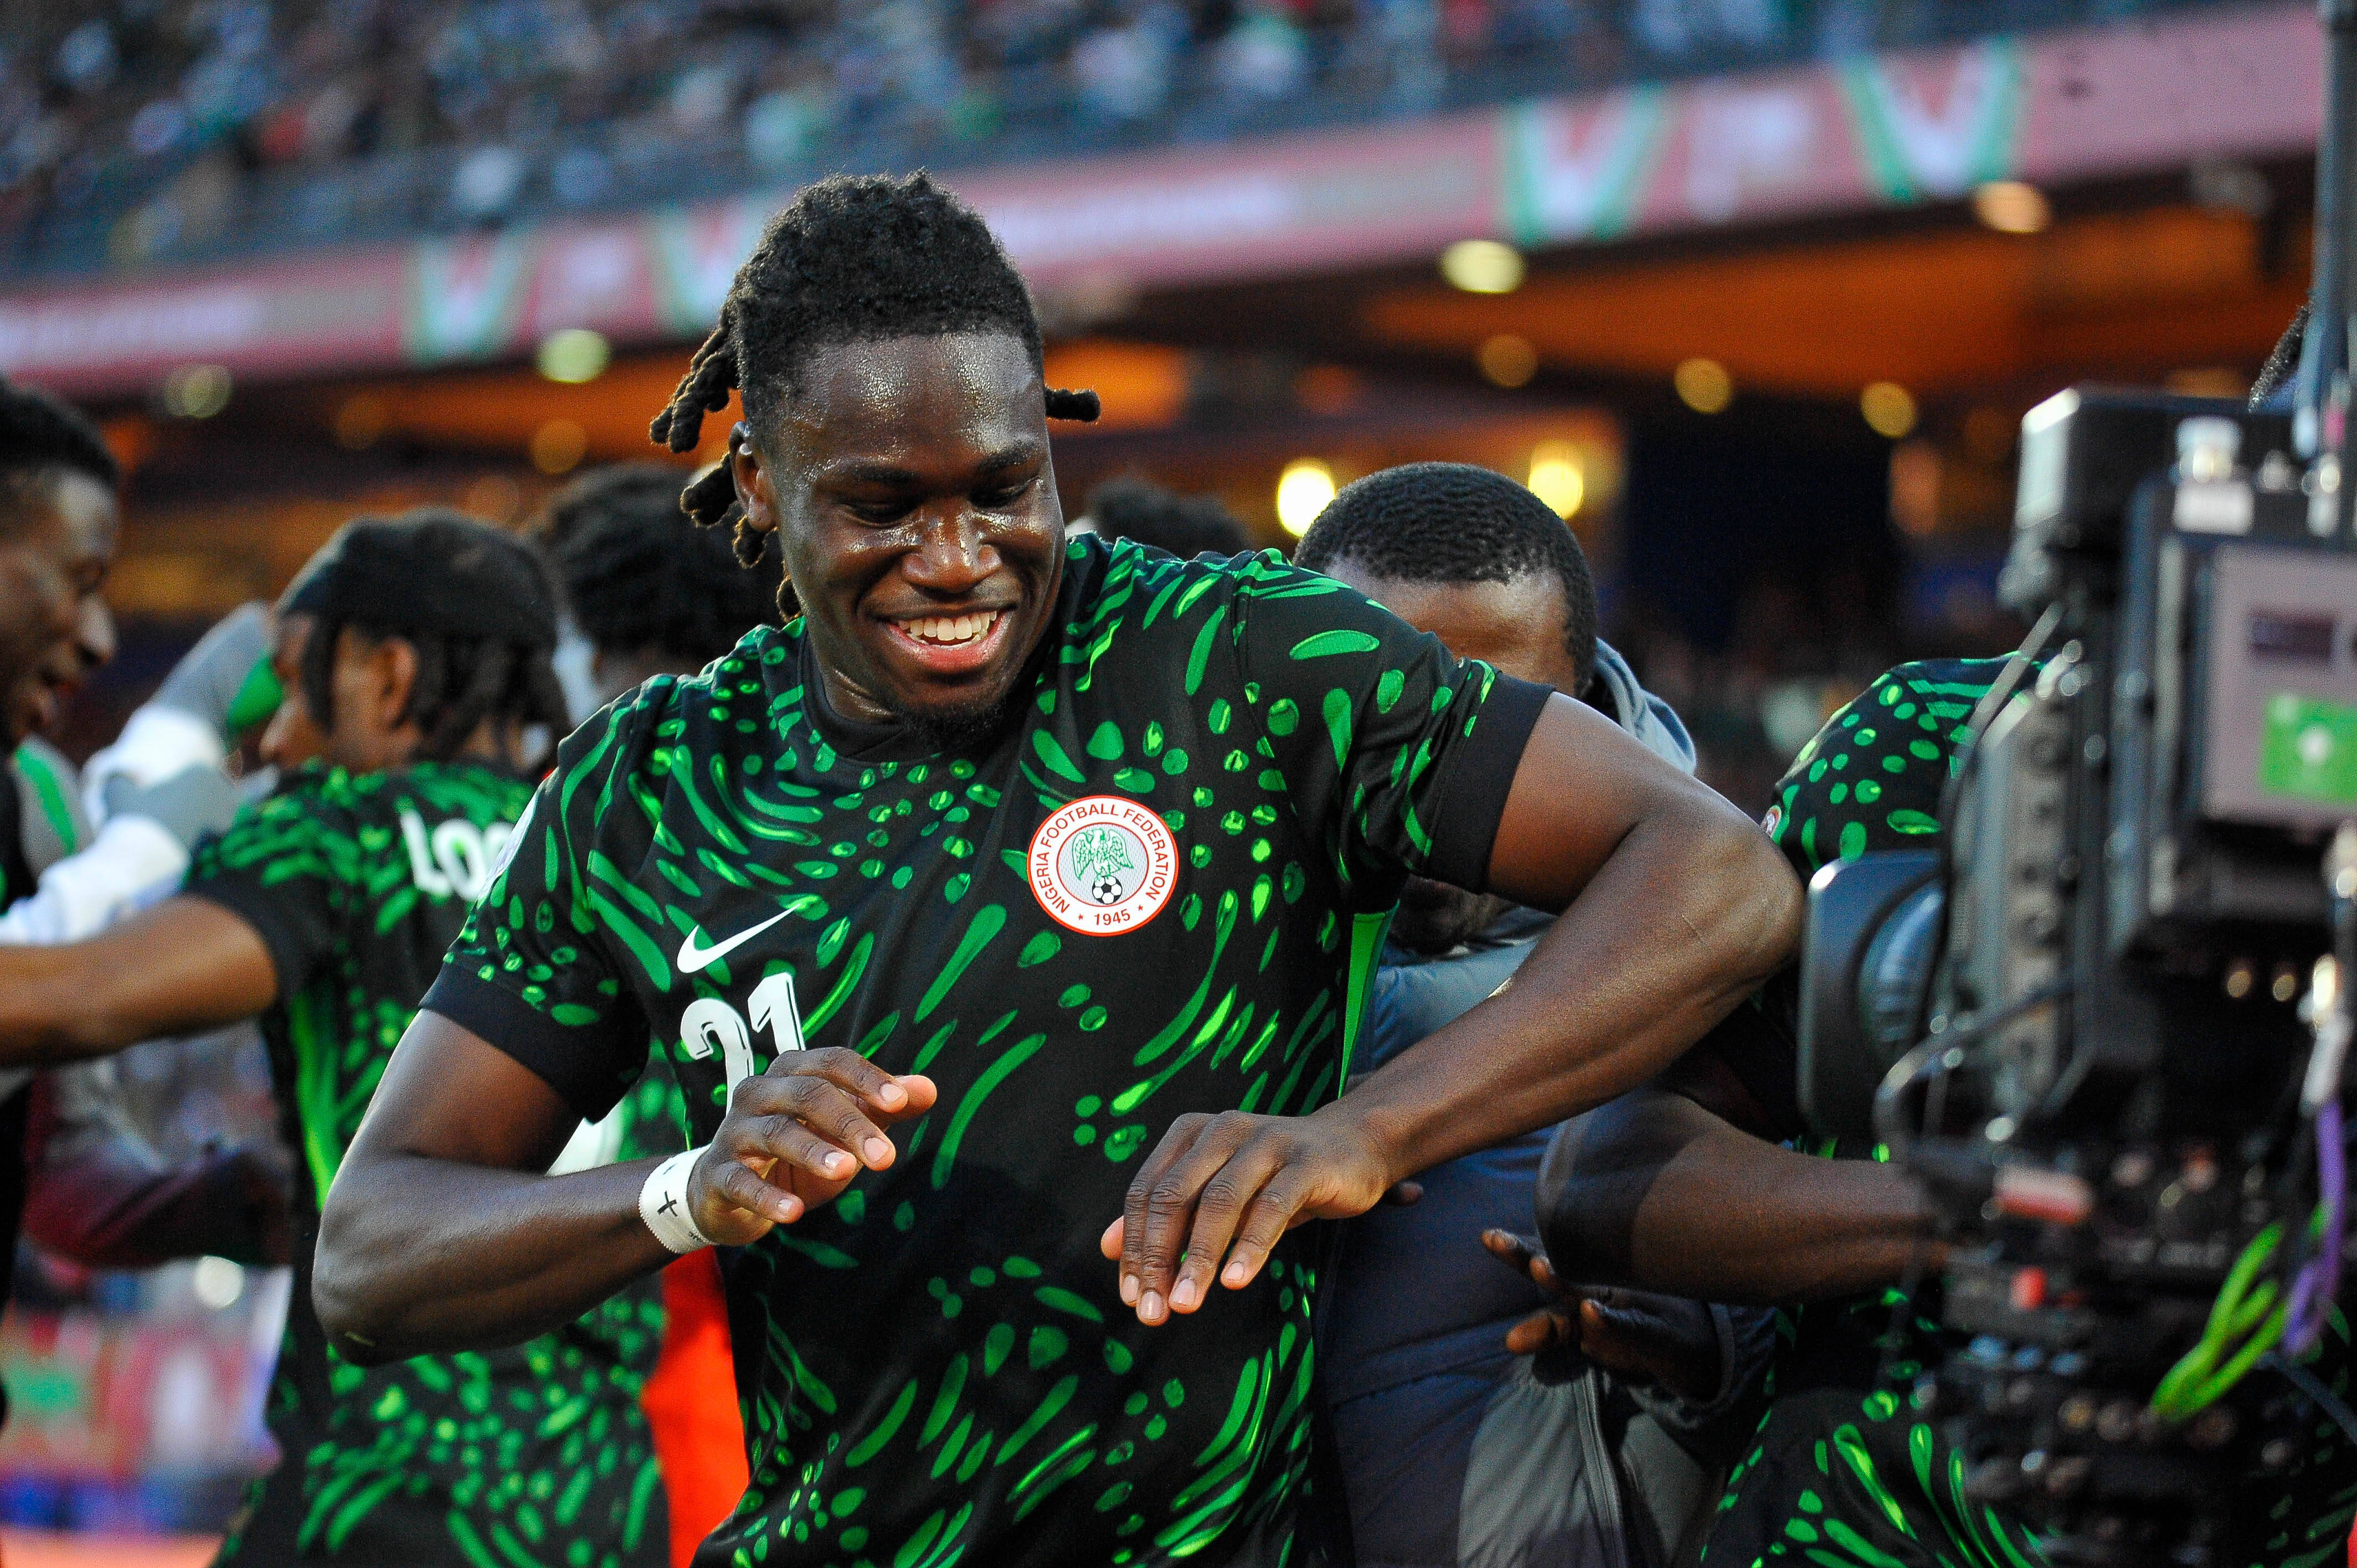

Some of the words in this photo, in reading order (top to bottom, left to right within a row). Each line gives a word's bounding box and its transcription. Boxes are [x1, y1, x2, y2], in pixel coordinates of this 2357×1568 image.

[1040, 803, 1119, 848] FOOTBALL
[1123, 808, 1169, 901] FEDERATION
[1036, 852, 1070, 914] NIGERIA
[1094, 908, 1131, 926] 1945
[680, 972, 806, 1117] 21
